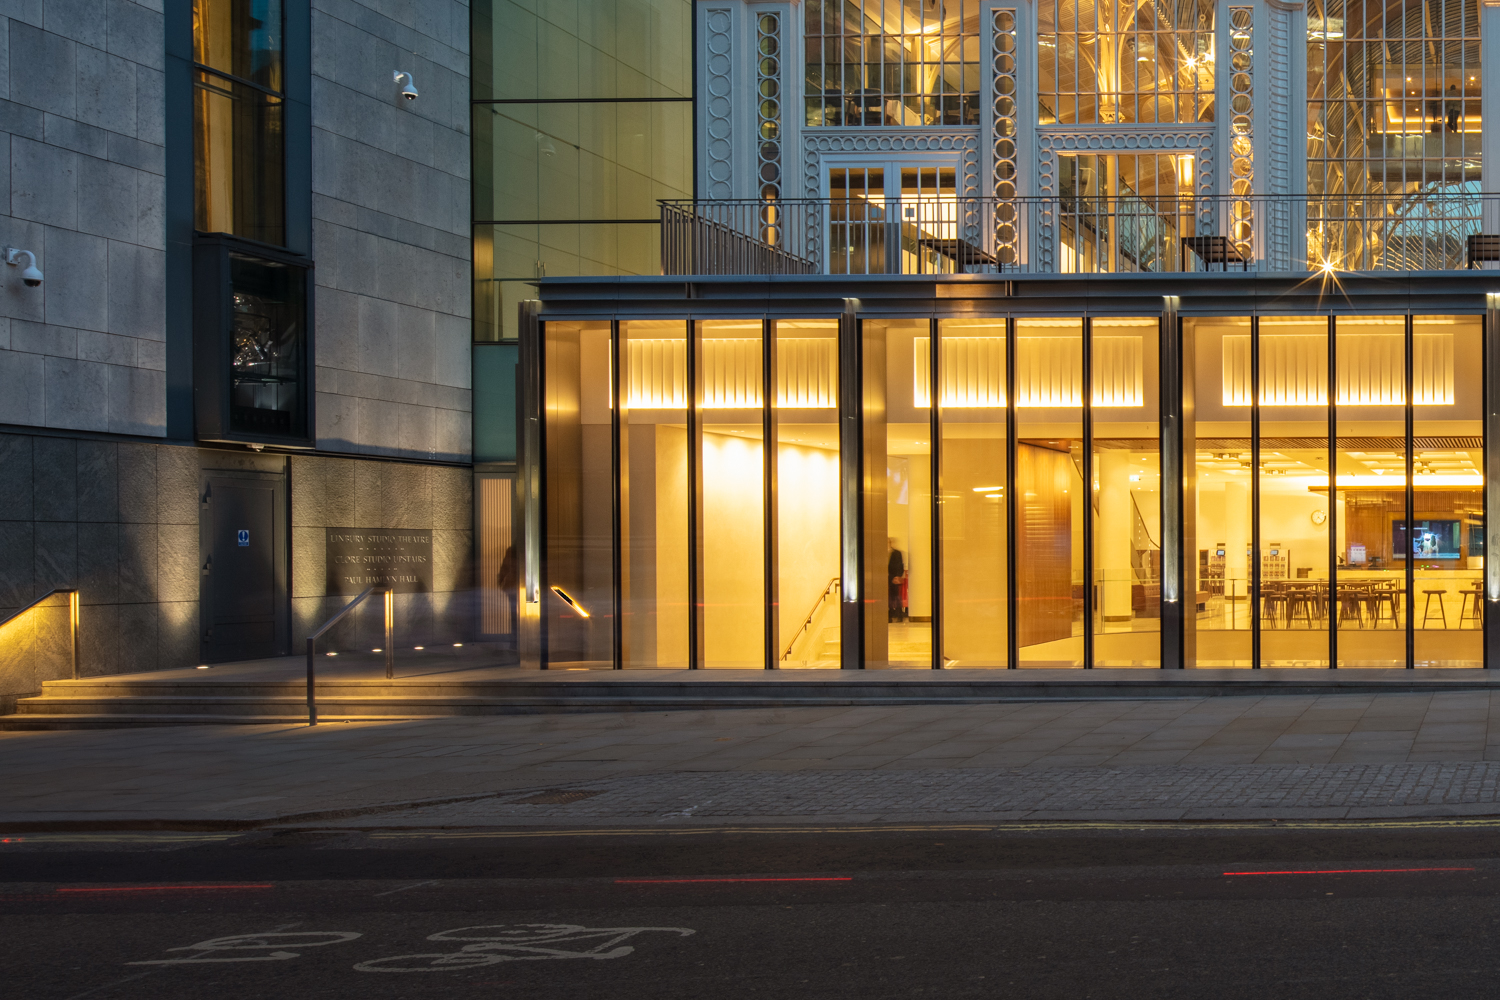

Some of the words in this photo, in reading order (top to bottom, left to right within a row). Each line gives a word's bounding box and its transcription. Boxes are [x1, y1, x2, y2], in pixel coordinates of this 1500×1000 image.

[330, 534, 365, 543] LINBURY
[367, 535, 396, 544] STUDIO
[398, 535, 430, 544] THEATRE
[335, 555, 360, 564] CLORE
[363, 555, 391, 564] STUDIO
[393, 555, 427, 564] UPSTAIRS
[344, 576, 363, 584] PAUL
[399, 575, 418, 583] HALL
